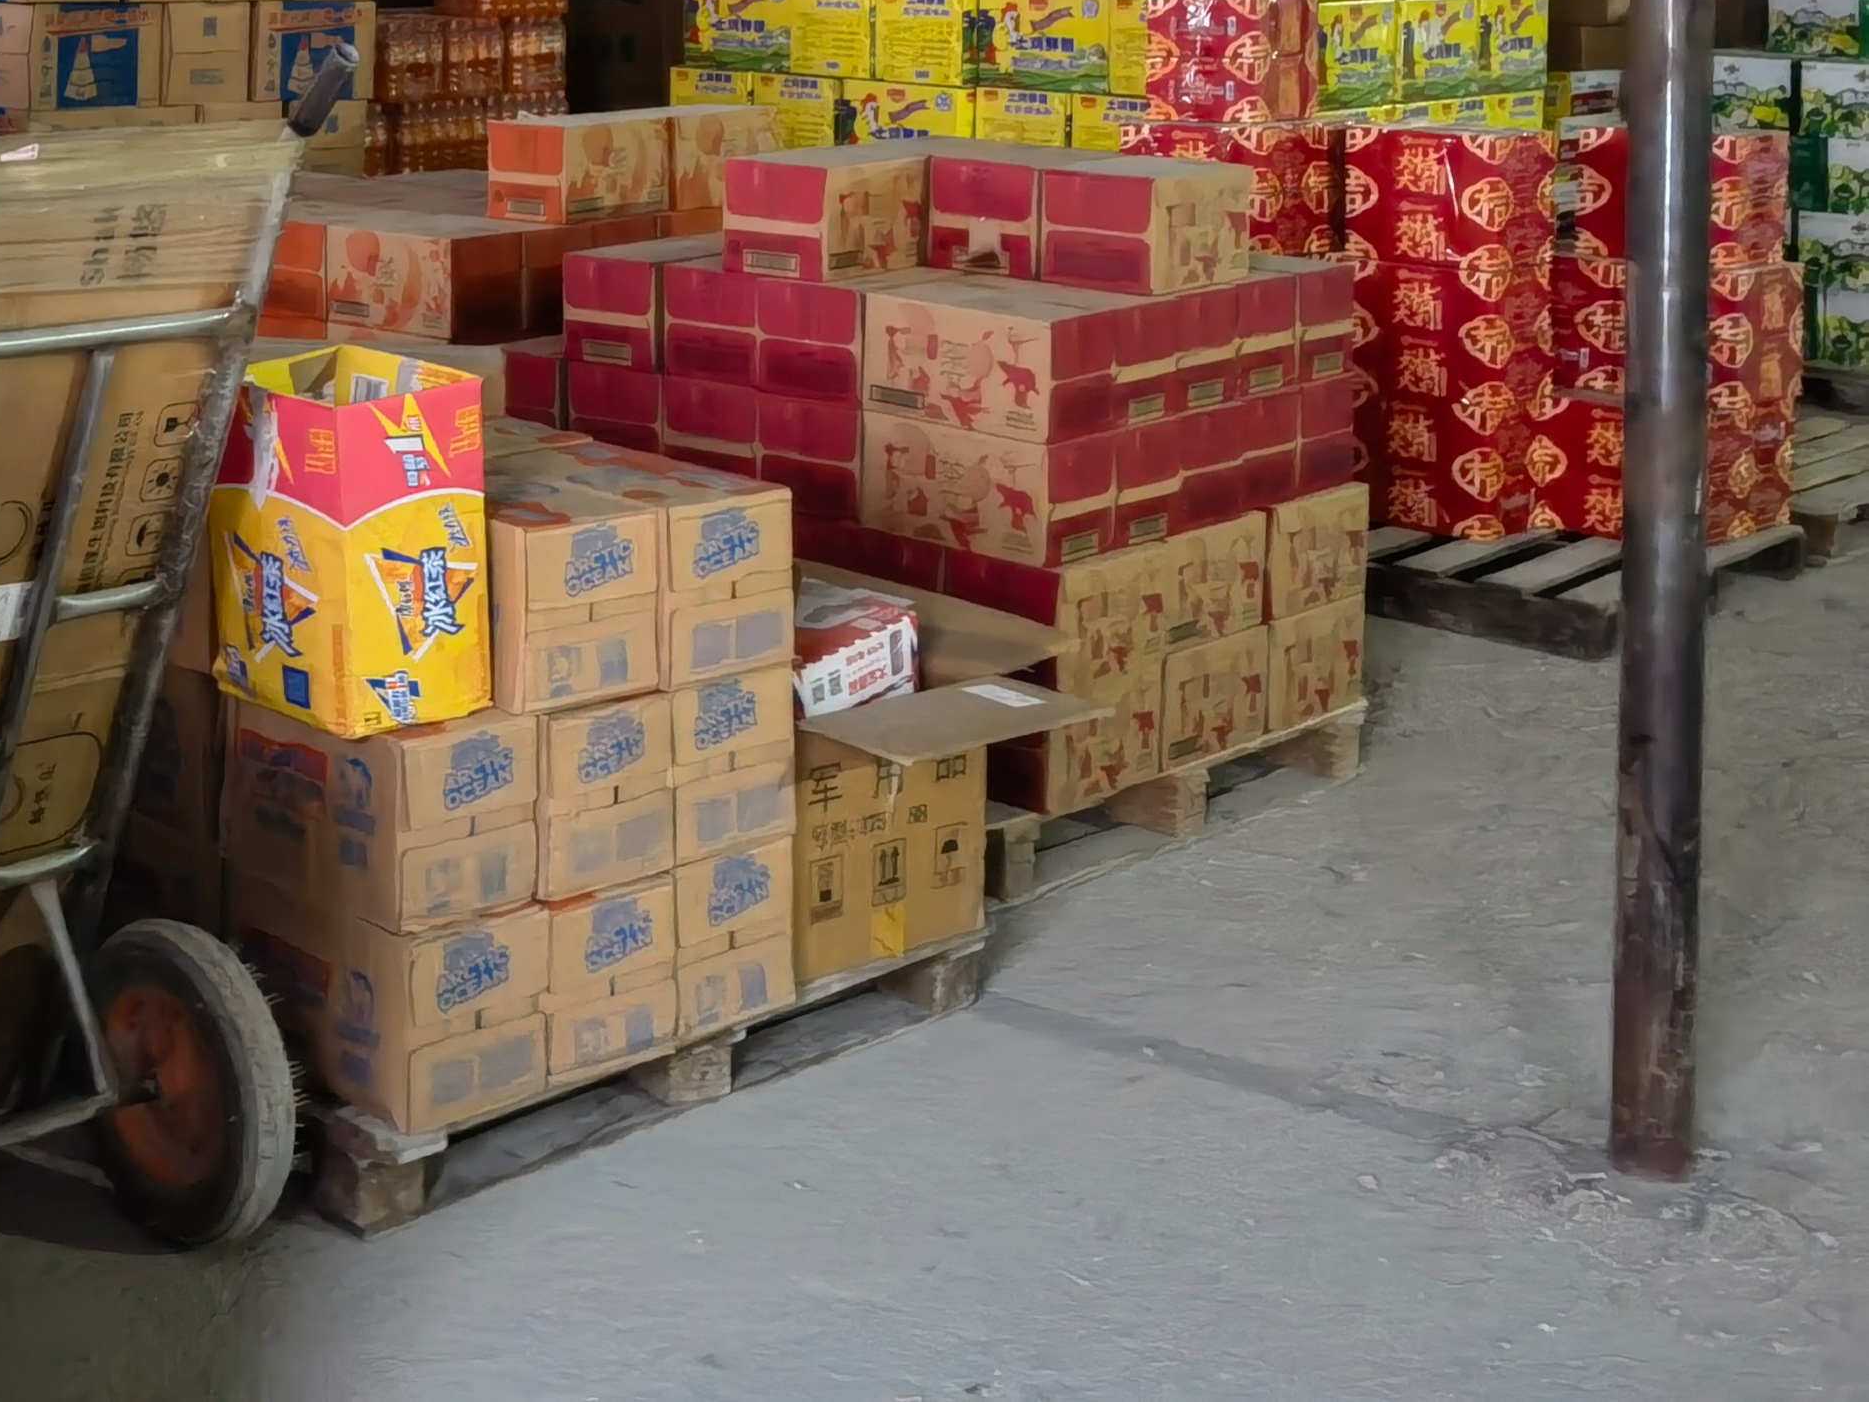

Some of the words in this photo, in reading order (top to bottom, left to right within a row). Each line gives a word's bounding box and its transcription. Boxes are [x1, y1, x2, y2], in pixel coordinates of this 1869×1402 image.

[565, 563, 633, 597] OCEAN
[566, 538, 633, 580] ARCTIC
[693, 541, 759, 579] OCEAN
[260, 550, 303, 658] 冰红茶
[420, 547, 465, 638] 冰红茶
